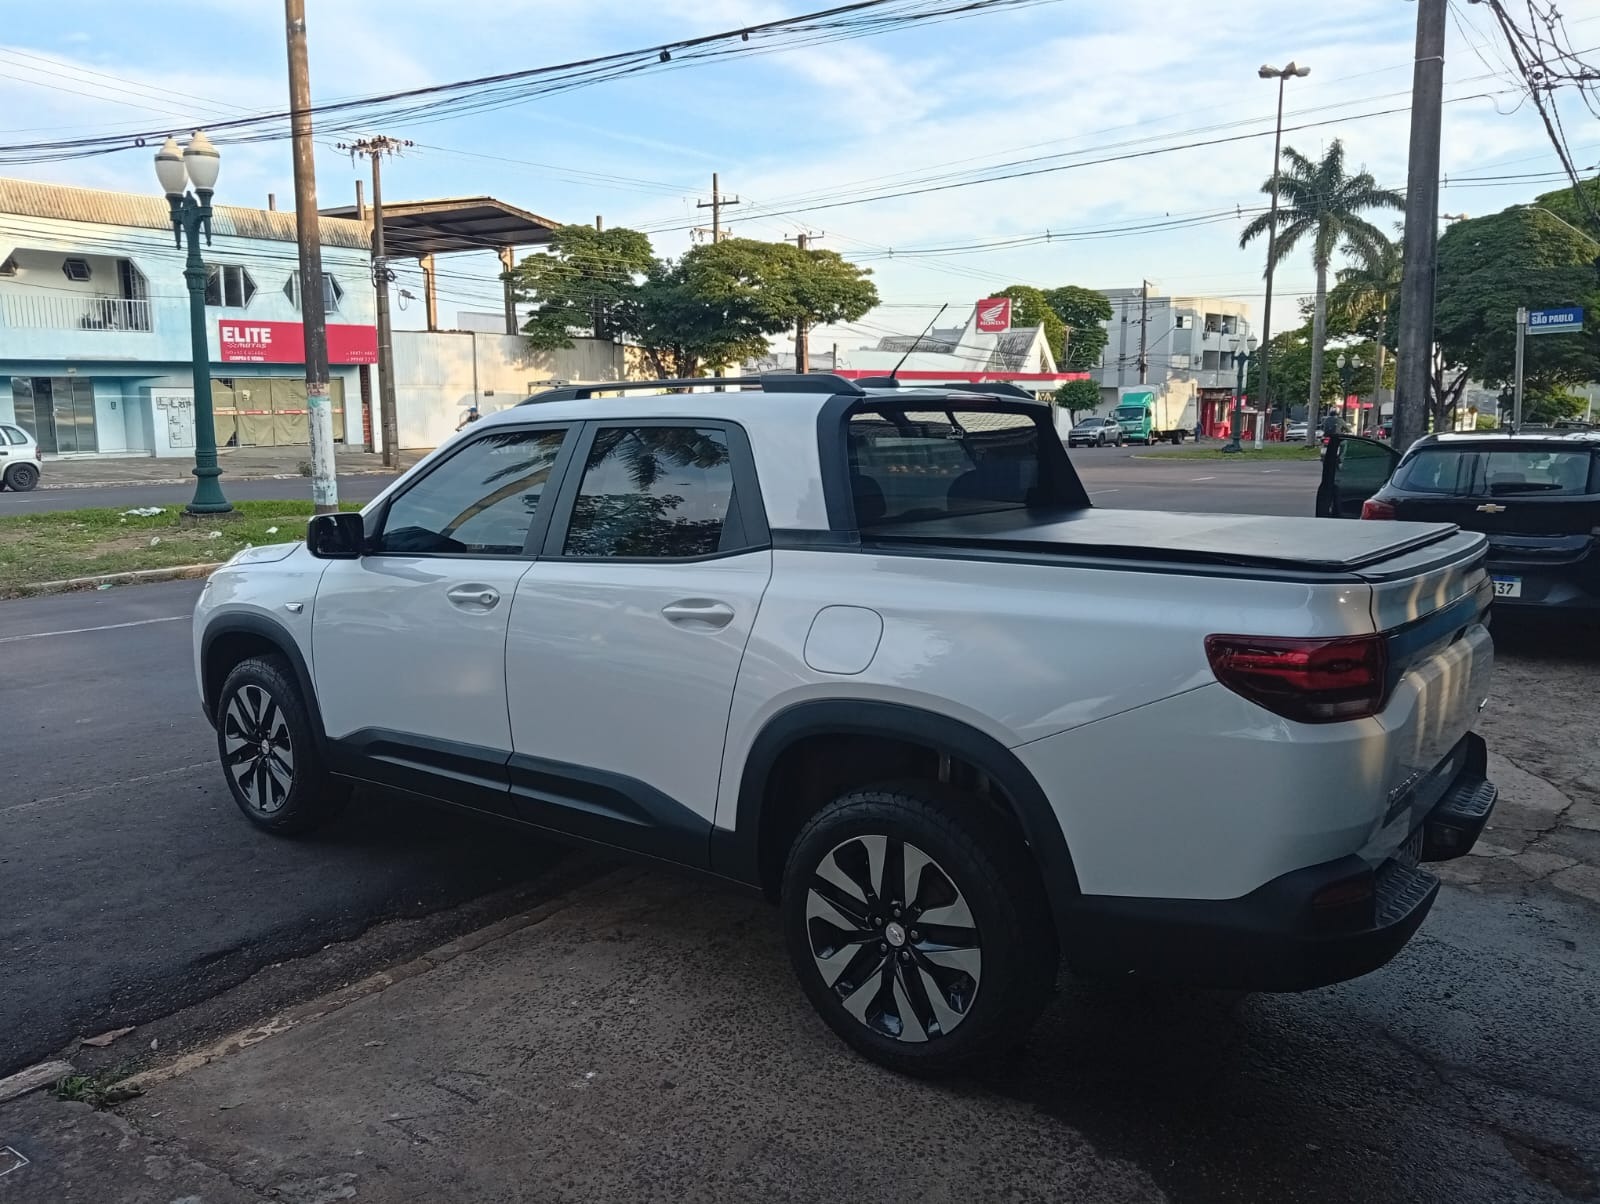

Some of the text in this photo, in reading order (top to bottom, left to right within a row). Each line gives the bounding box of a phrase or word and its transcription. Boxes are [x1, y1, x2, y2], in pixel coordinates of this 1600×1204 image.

[1531, 314, 1547, 325] SÃO
[1548, 313, 1574, 323] PAULO
[222, 326, 272, 344] ELITE
